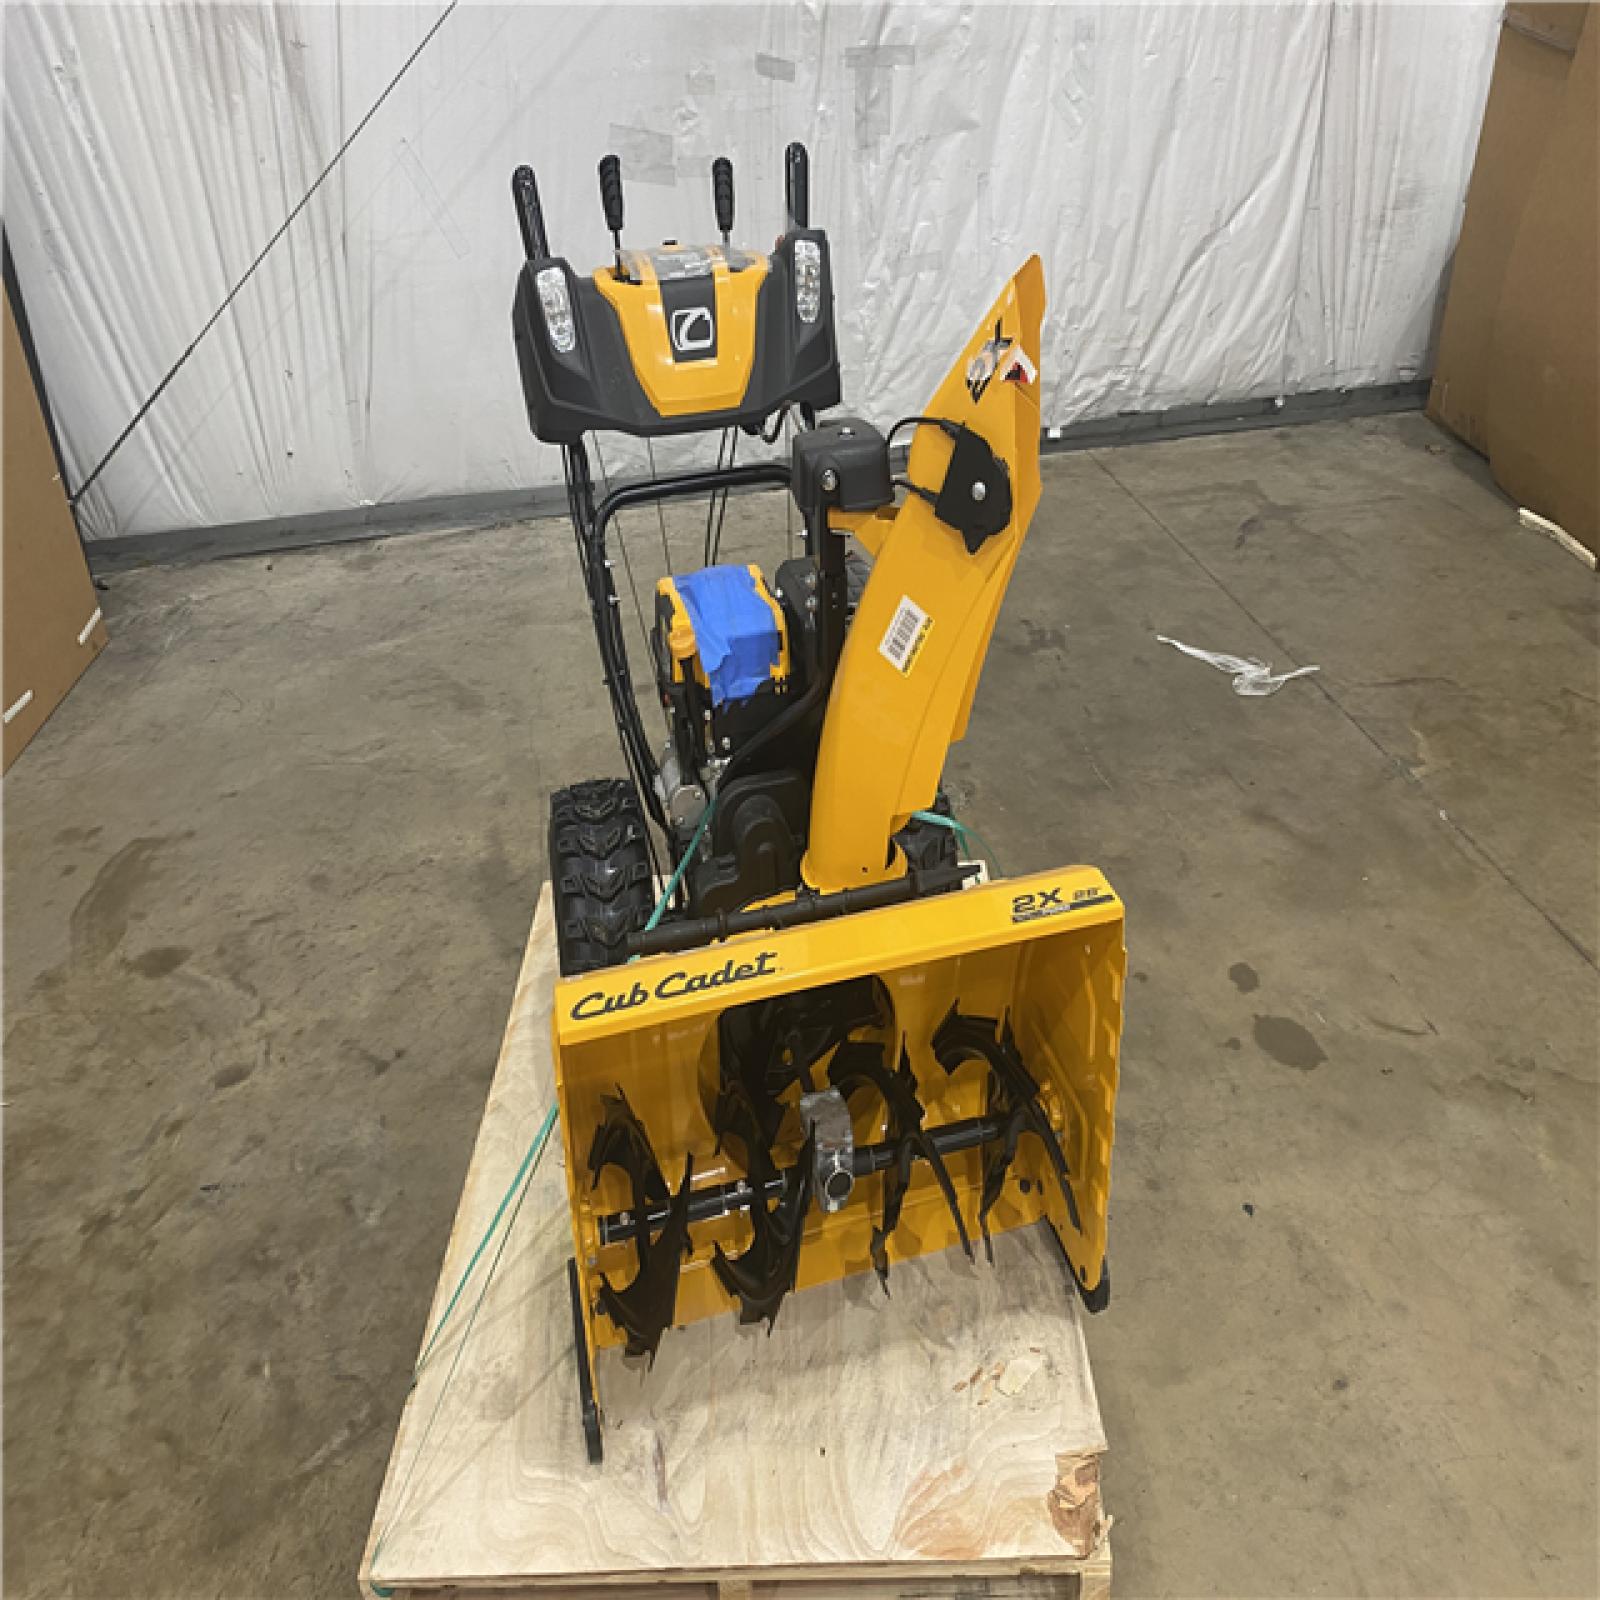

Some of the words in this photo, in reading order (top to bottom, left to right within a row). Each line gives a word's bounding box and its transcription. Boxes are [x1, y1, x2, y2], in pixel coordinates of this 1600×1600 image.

[1012, 887, 1062, 912] 2X
[570, 982, 649, 1020] Cub
[654, 952, 778, 999] Cadet
